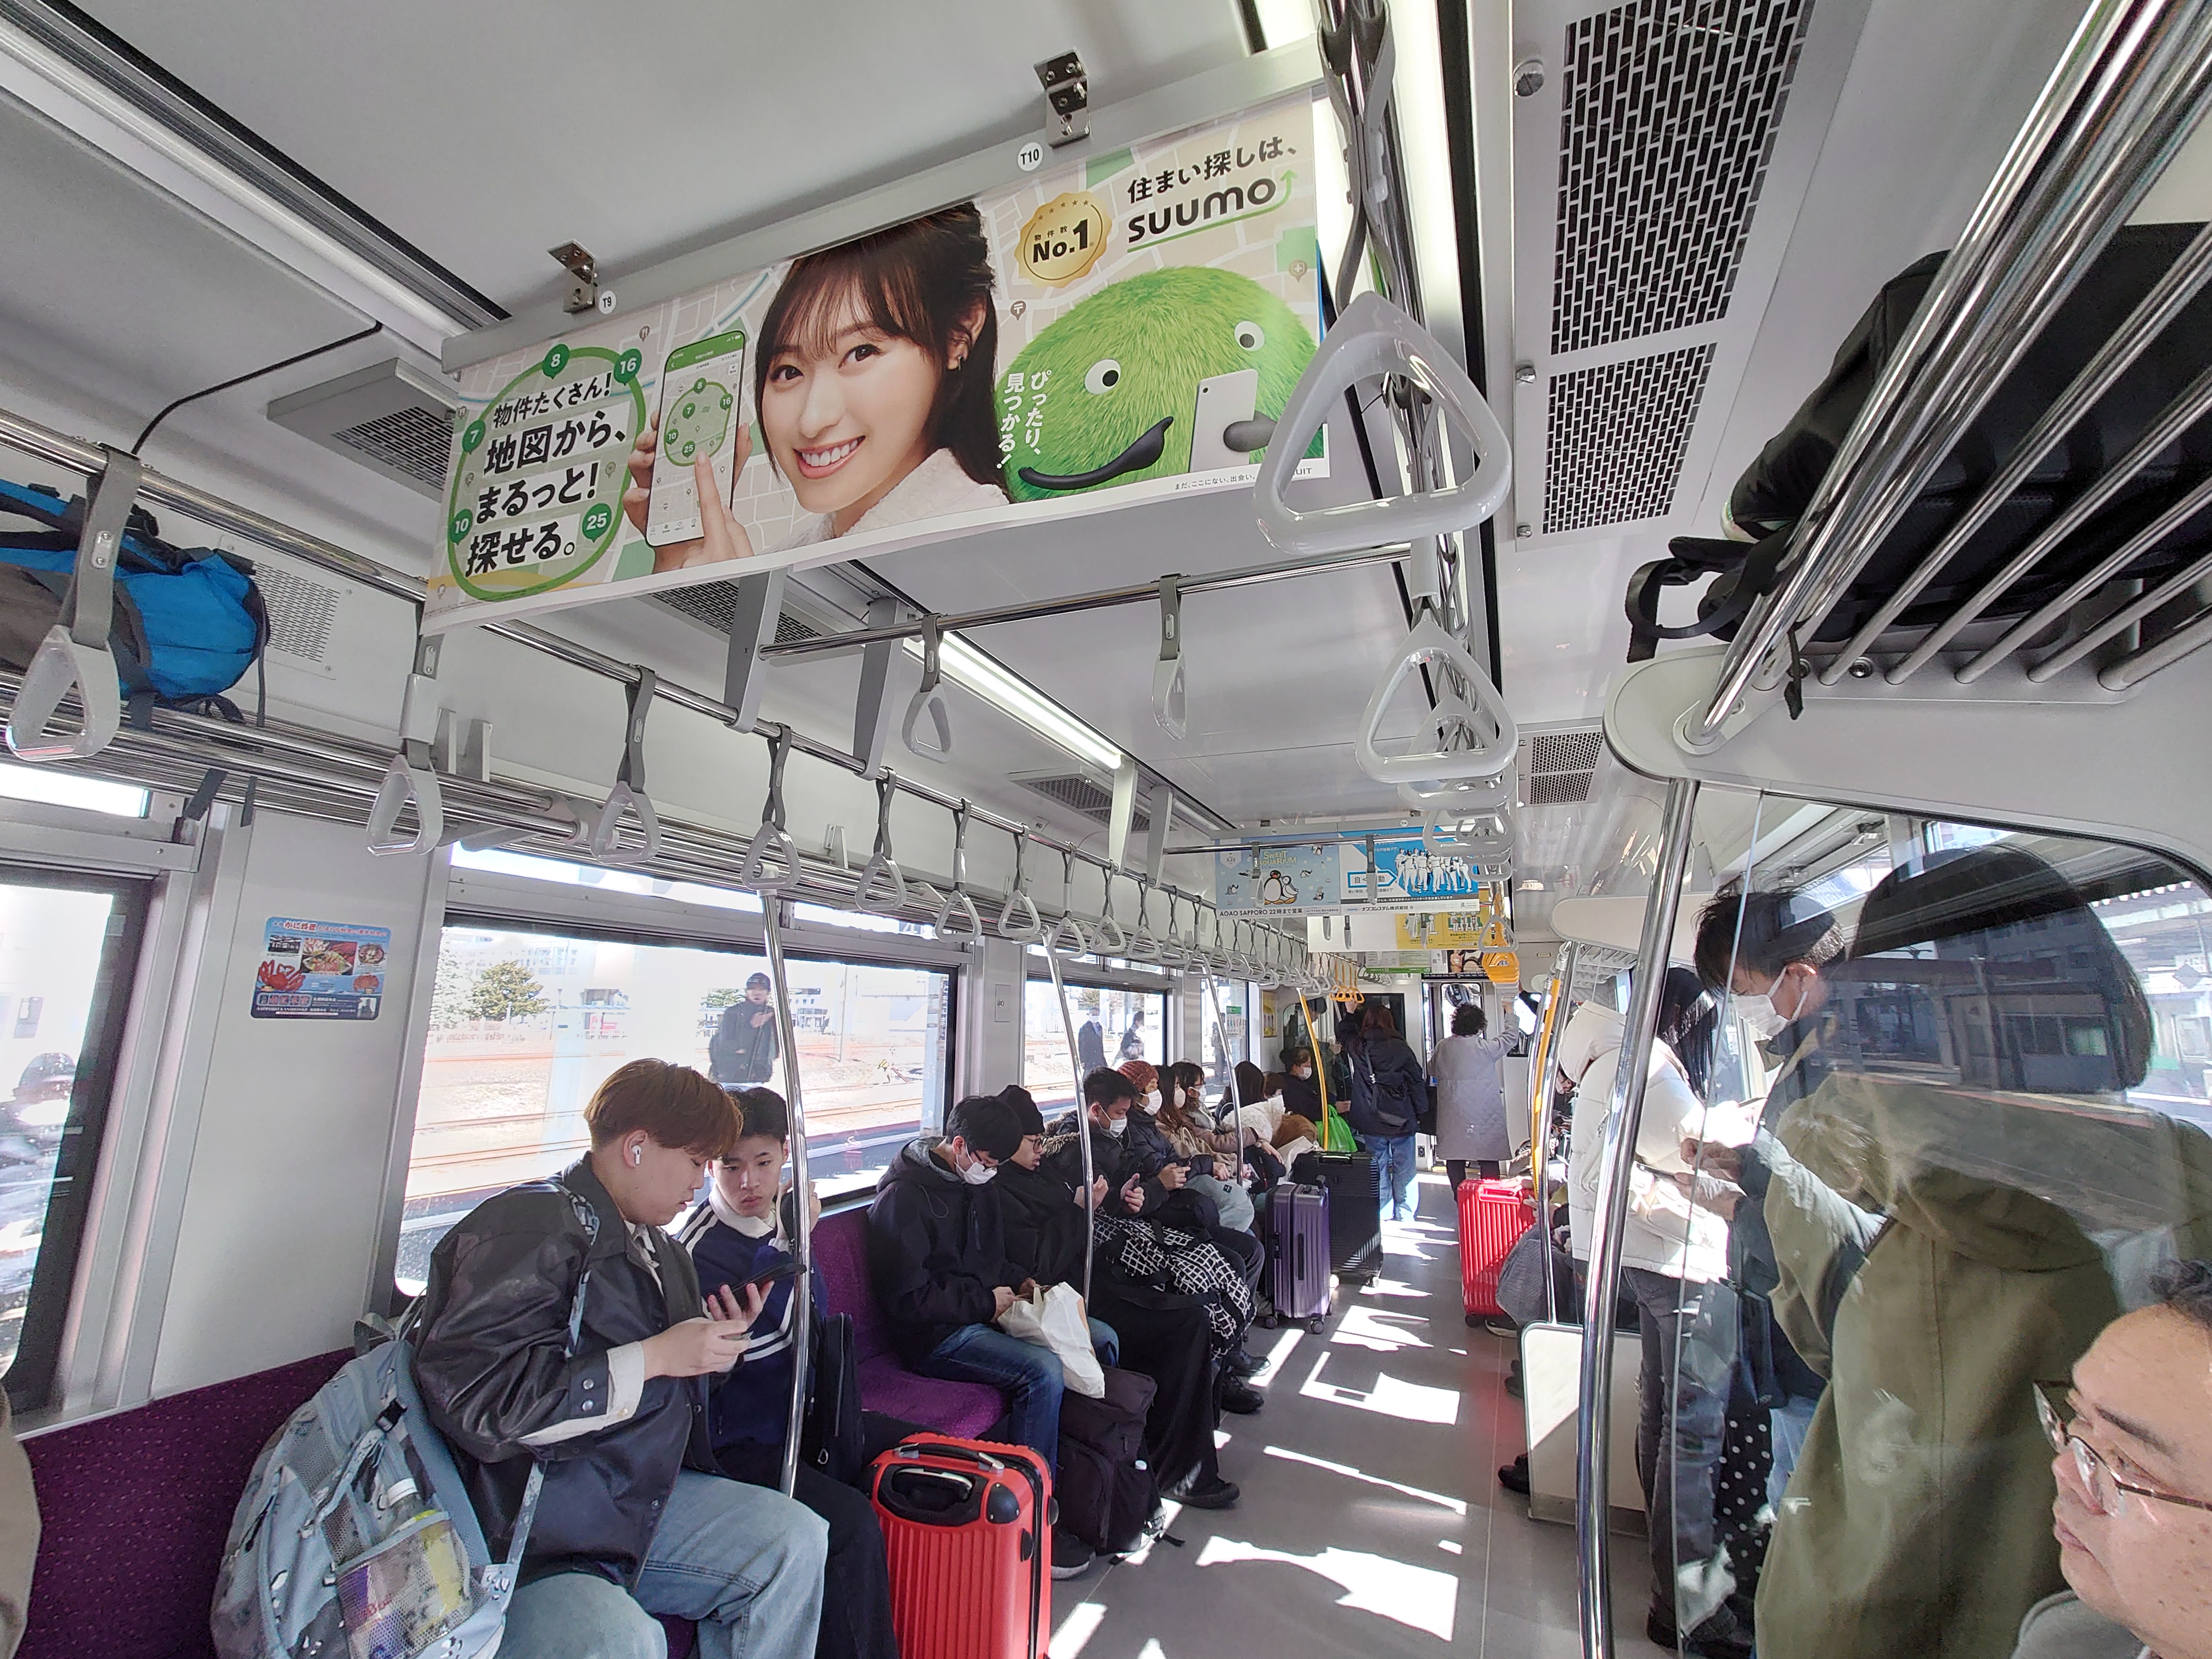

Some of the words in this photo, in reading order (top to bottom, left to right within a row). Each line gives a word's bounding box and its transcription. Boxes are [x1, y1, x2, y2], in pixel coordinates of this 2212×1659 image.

[1020, 150, 1040, 165] T10
[1127, 136, 1296, 204] 住まい探しは、
[1033, 218, 1088, 263] No.1
[1034, 225, 1068, 241] 物件数
[602, 296, 612, 308] T9
[550, 353, 561, 368] 8
[618, 359, 637, 373] 16
[493, 372, 612, 428] 物件たくさん!
[1024, 369, 1052, 455] ぴったり、
[470, 430, 478, 443] 7
[484, 410, 626, 475] 地図から、
[668, 432, 677, 441] 10
[684, 444, 694, 453] 25
[1175, 474, 1256, 490] まだ、ここにない、出会い。
[476, 462, 599, 524] まるっと!
[455, 518, 469, 532] 10
[586, 513, 607, 531] 25
[465, 522, 575, 578] 探せる。
[1263, 850, 1288, 859] SWEET
